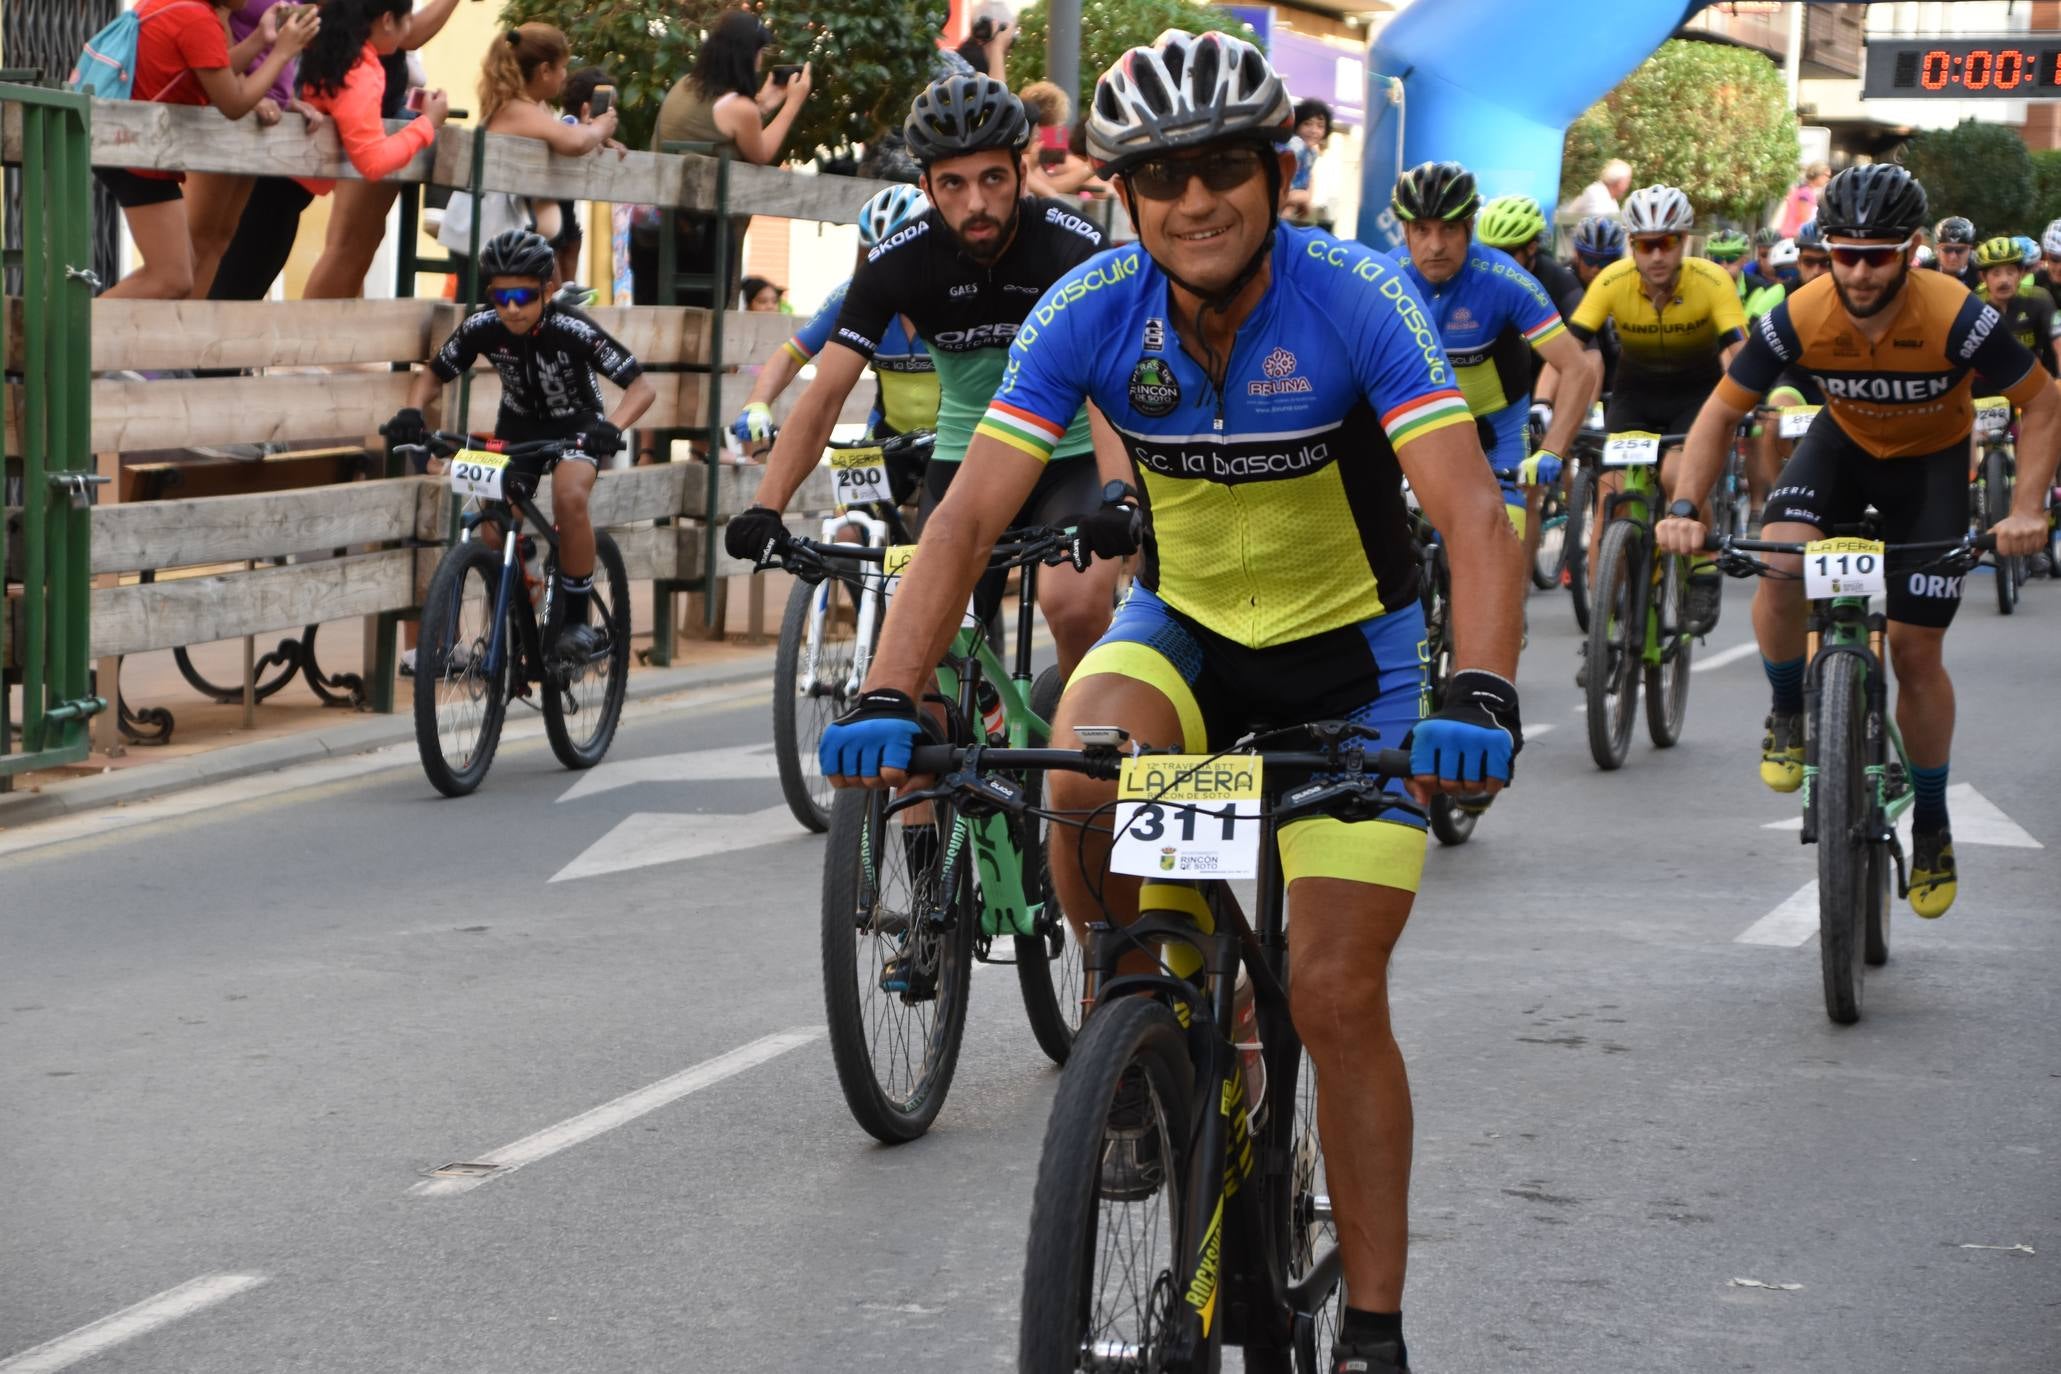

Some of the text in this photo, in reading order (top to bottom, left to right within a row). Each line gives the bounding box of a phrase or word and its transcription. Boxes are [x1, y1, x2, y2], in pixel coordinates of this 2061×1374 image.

[1921, 50, 2061, 90] 0:00:
[949, 282, 978, 297] GAES
[1015, 324, 1039, 353] la
[1034, 253, 1140, 328] bascula
[1352, 256, 1385, 282] la
[1378, 275, 1447, 386] bascula
[1959, 303, 2000, 360] ORKOIE
[1247, 376, 1313, 397] BRUNA
[1612, 440, 1652, 450] 254
[1181, 451, 1207, 473] la
[1212, 442, 1329, 476] bascula
[456, 463, 497, 484] 207
[837, 467, 881, 487] 200
[1836, 541, 1880, 552] PERA
[1815, 554, 1876, 577] 110
[1214, 762, 1235, 770] BTT
[1127, 770, 1253, 792] LA PERA
[1186, 792, 1199, 800] DE
[1202, 792, 1231, 800] SOTO
[1129, 802, 1237, 842] 311
